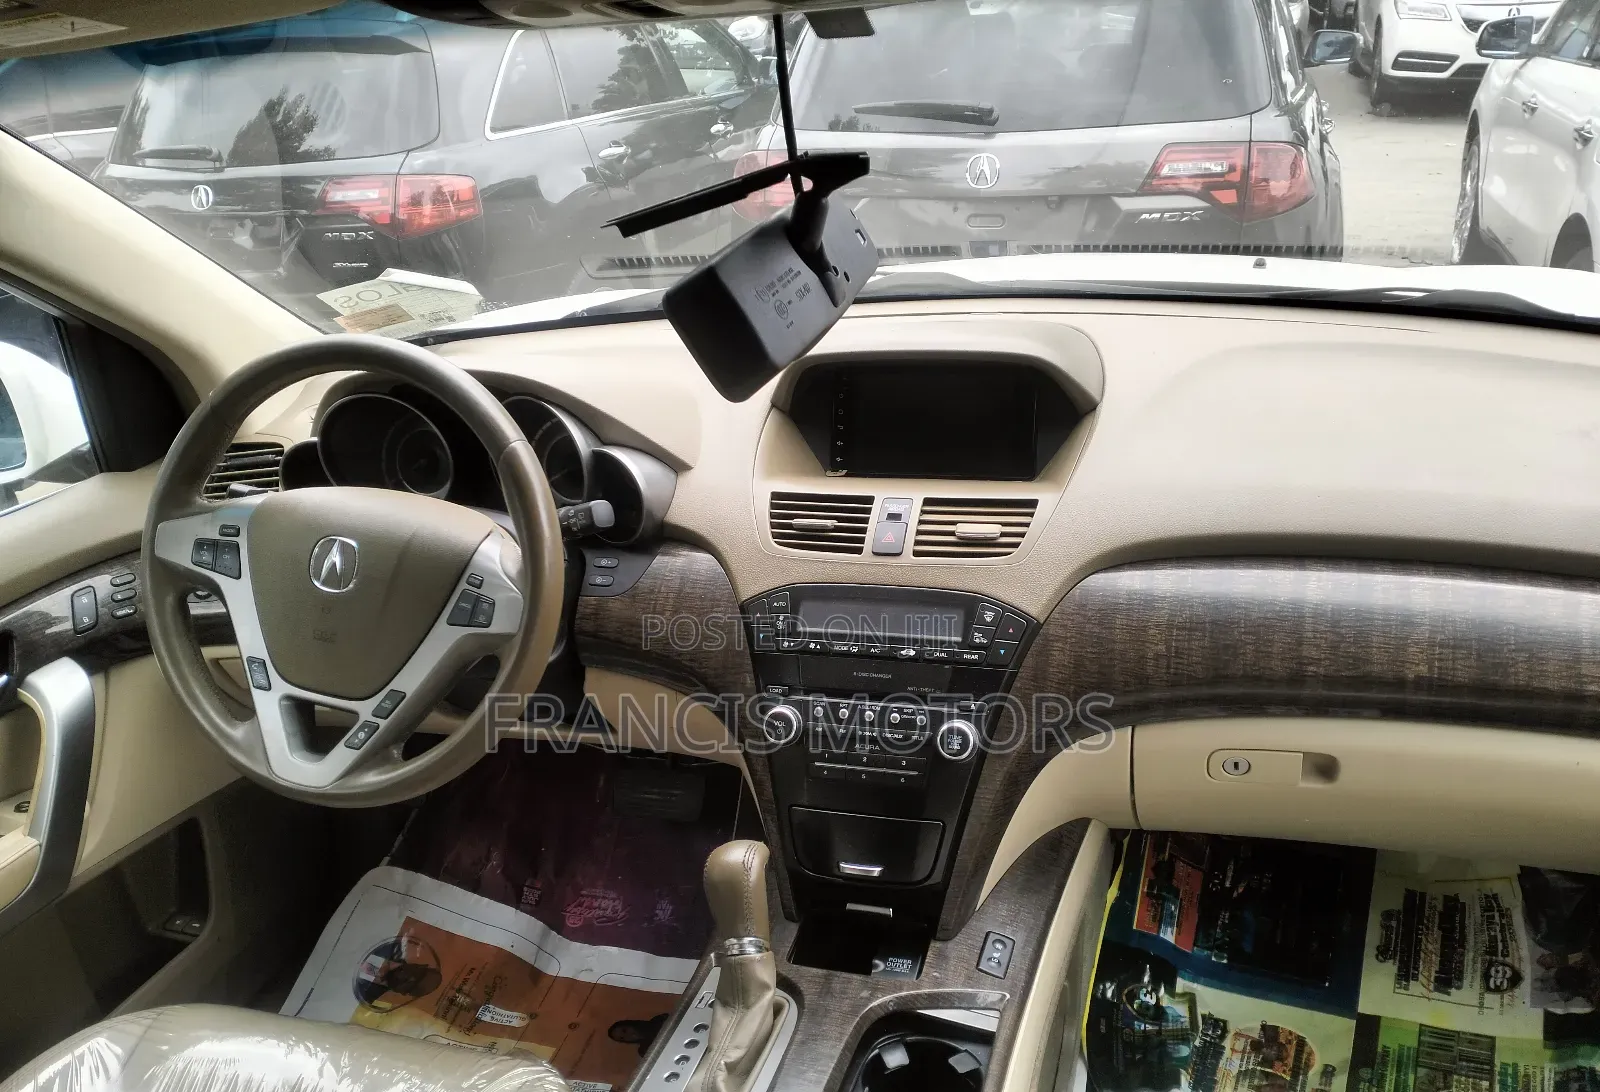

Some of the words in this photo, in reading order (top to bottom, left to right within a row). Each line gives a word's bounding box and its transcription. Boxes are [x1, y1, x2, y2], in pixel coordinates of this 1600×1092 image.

[1135, 210, 1204, 223] MDX
[322, 230, 374, 241] MDX
[773, 719, 786, 727] VOL
[855, 743, 880, 751] ACURA
[886, 961, 912, 969] OUTLET
[888, 957, 912, 965] POWER
[1489, 965, 1513, 990] 39
